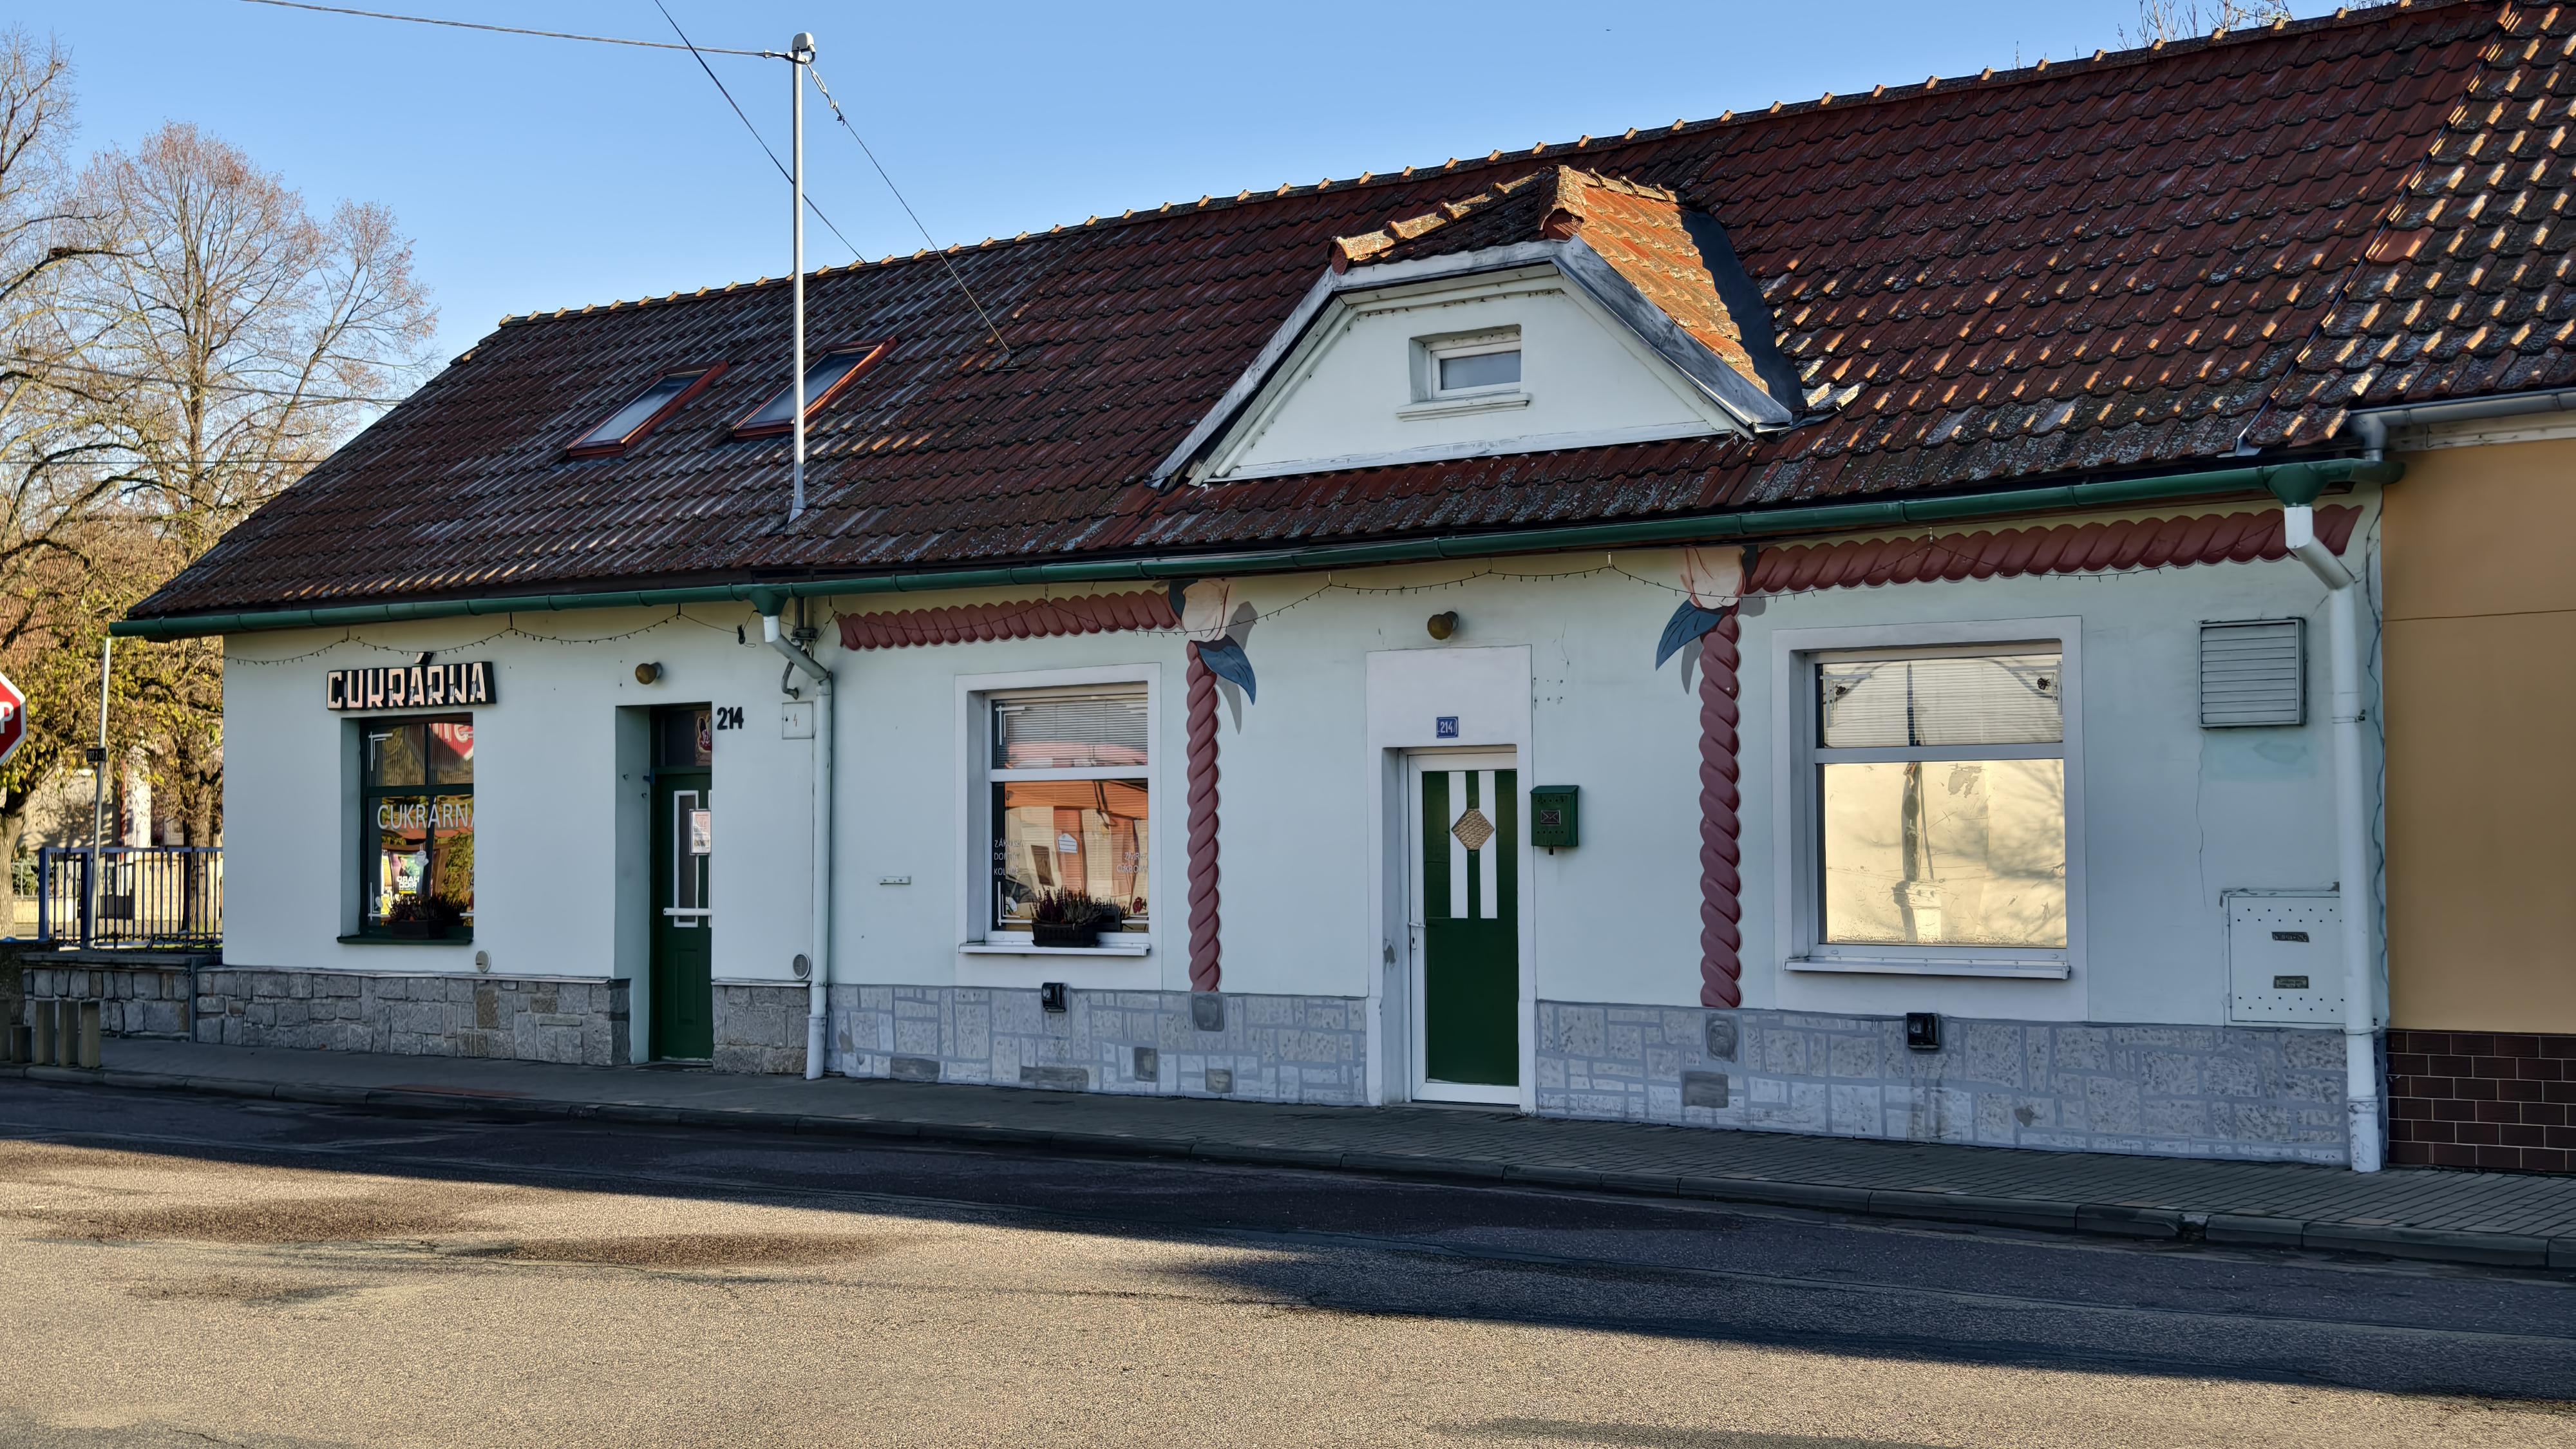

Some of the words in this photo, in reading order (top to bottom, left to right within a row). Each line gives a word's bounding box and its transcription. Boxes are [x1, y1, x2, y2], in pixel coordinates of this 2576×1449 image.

[327, 652, 488, 708] CUKRÁRNA
[717, 706, 744, 730] 214
[1440, 721, 1453, 734] 214
[377, 797, 473, 829] CUKRÁRN
